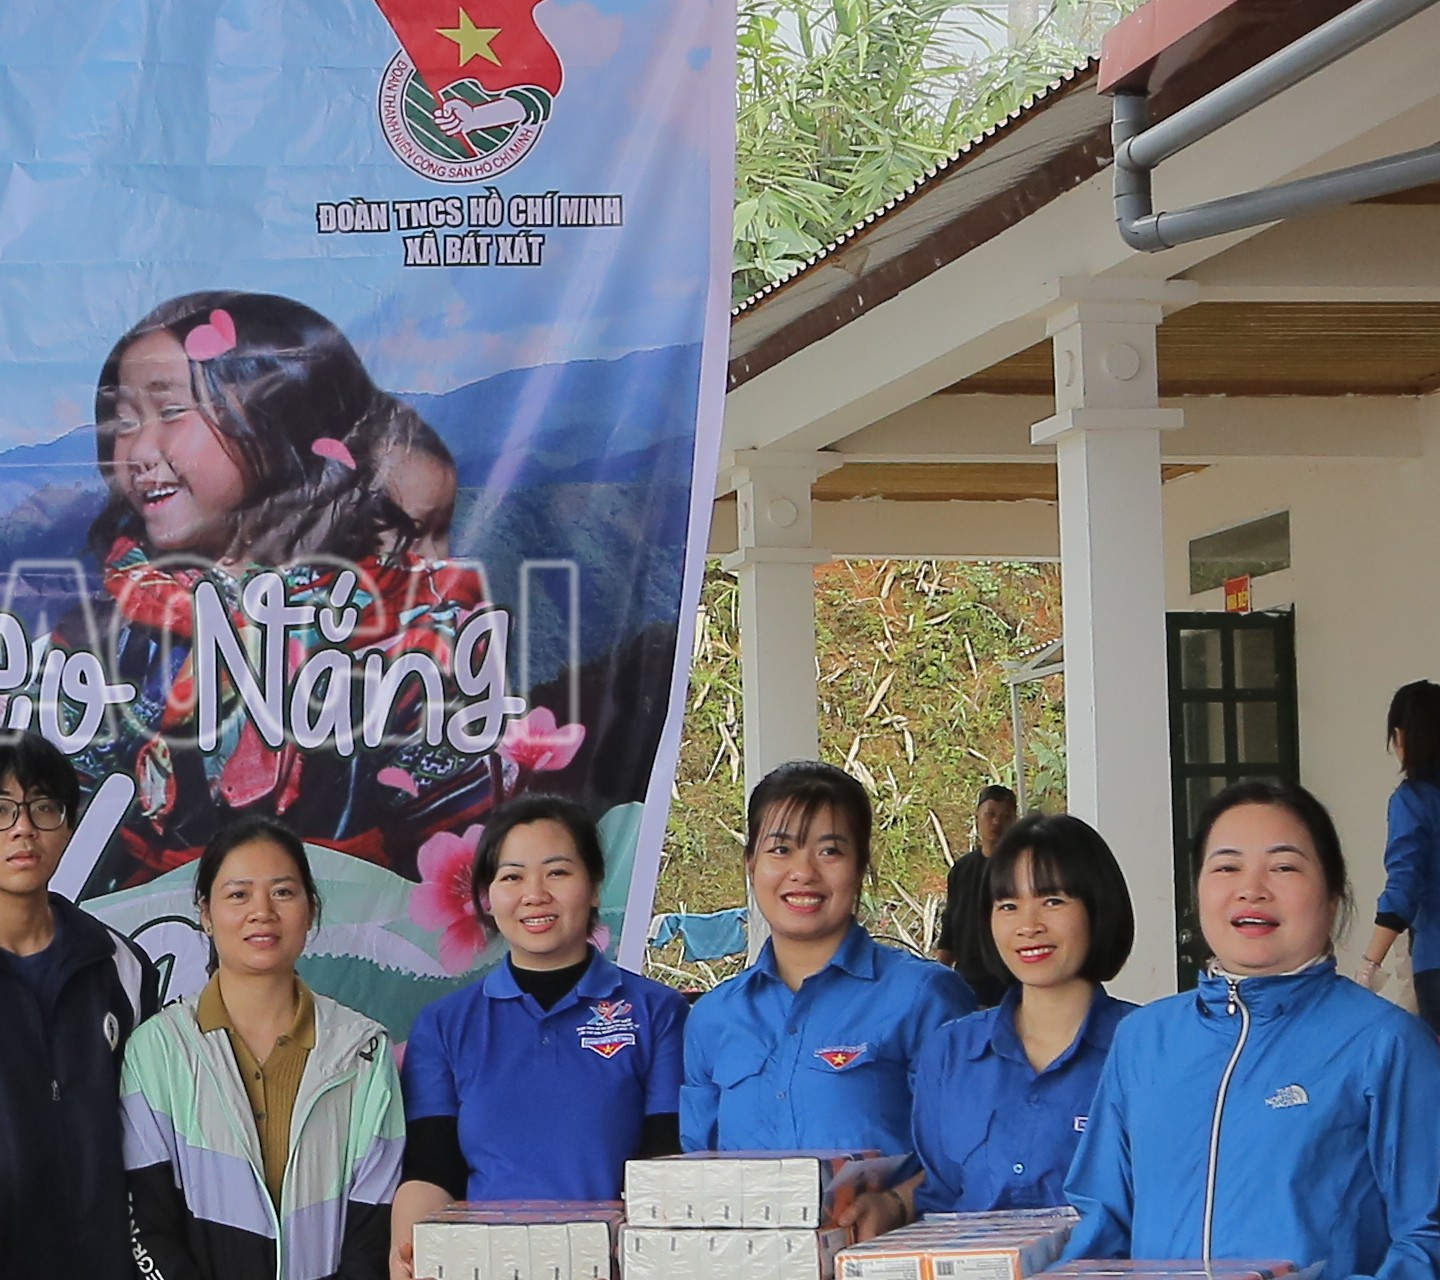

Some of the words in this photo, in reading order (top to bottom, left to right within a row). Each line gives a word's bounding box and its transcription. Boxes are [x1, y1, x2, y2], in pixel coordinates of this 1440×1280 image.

[317, 197, 389, 233] ĐOÀN
[394, 197, 462, 230] TNCS
[468, 187, 503, 227] HỒ
[508, 191, 558, 227] CHÍ
[559, 195, 624, 227] MINH
[403, 229, 441, 266] XÃ
[444, 230, 492, 266] BÁT
[495, 230, 544, 266] XÁT
[195, 570, 525, 756] Nắng
